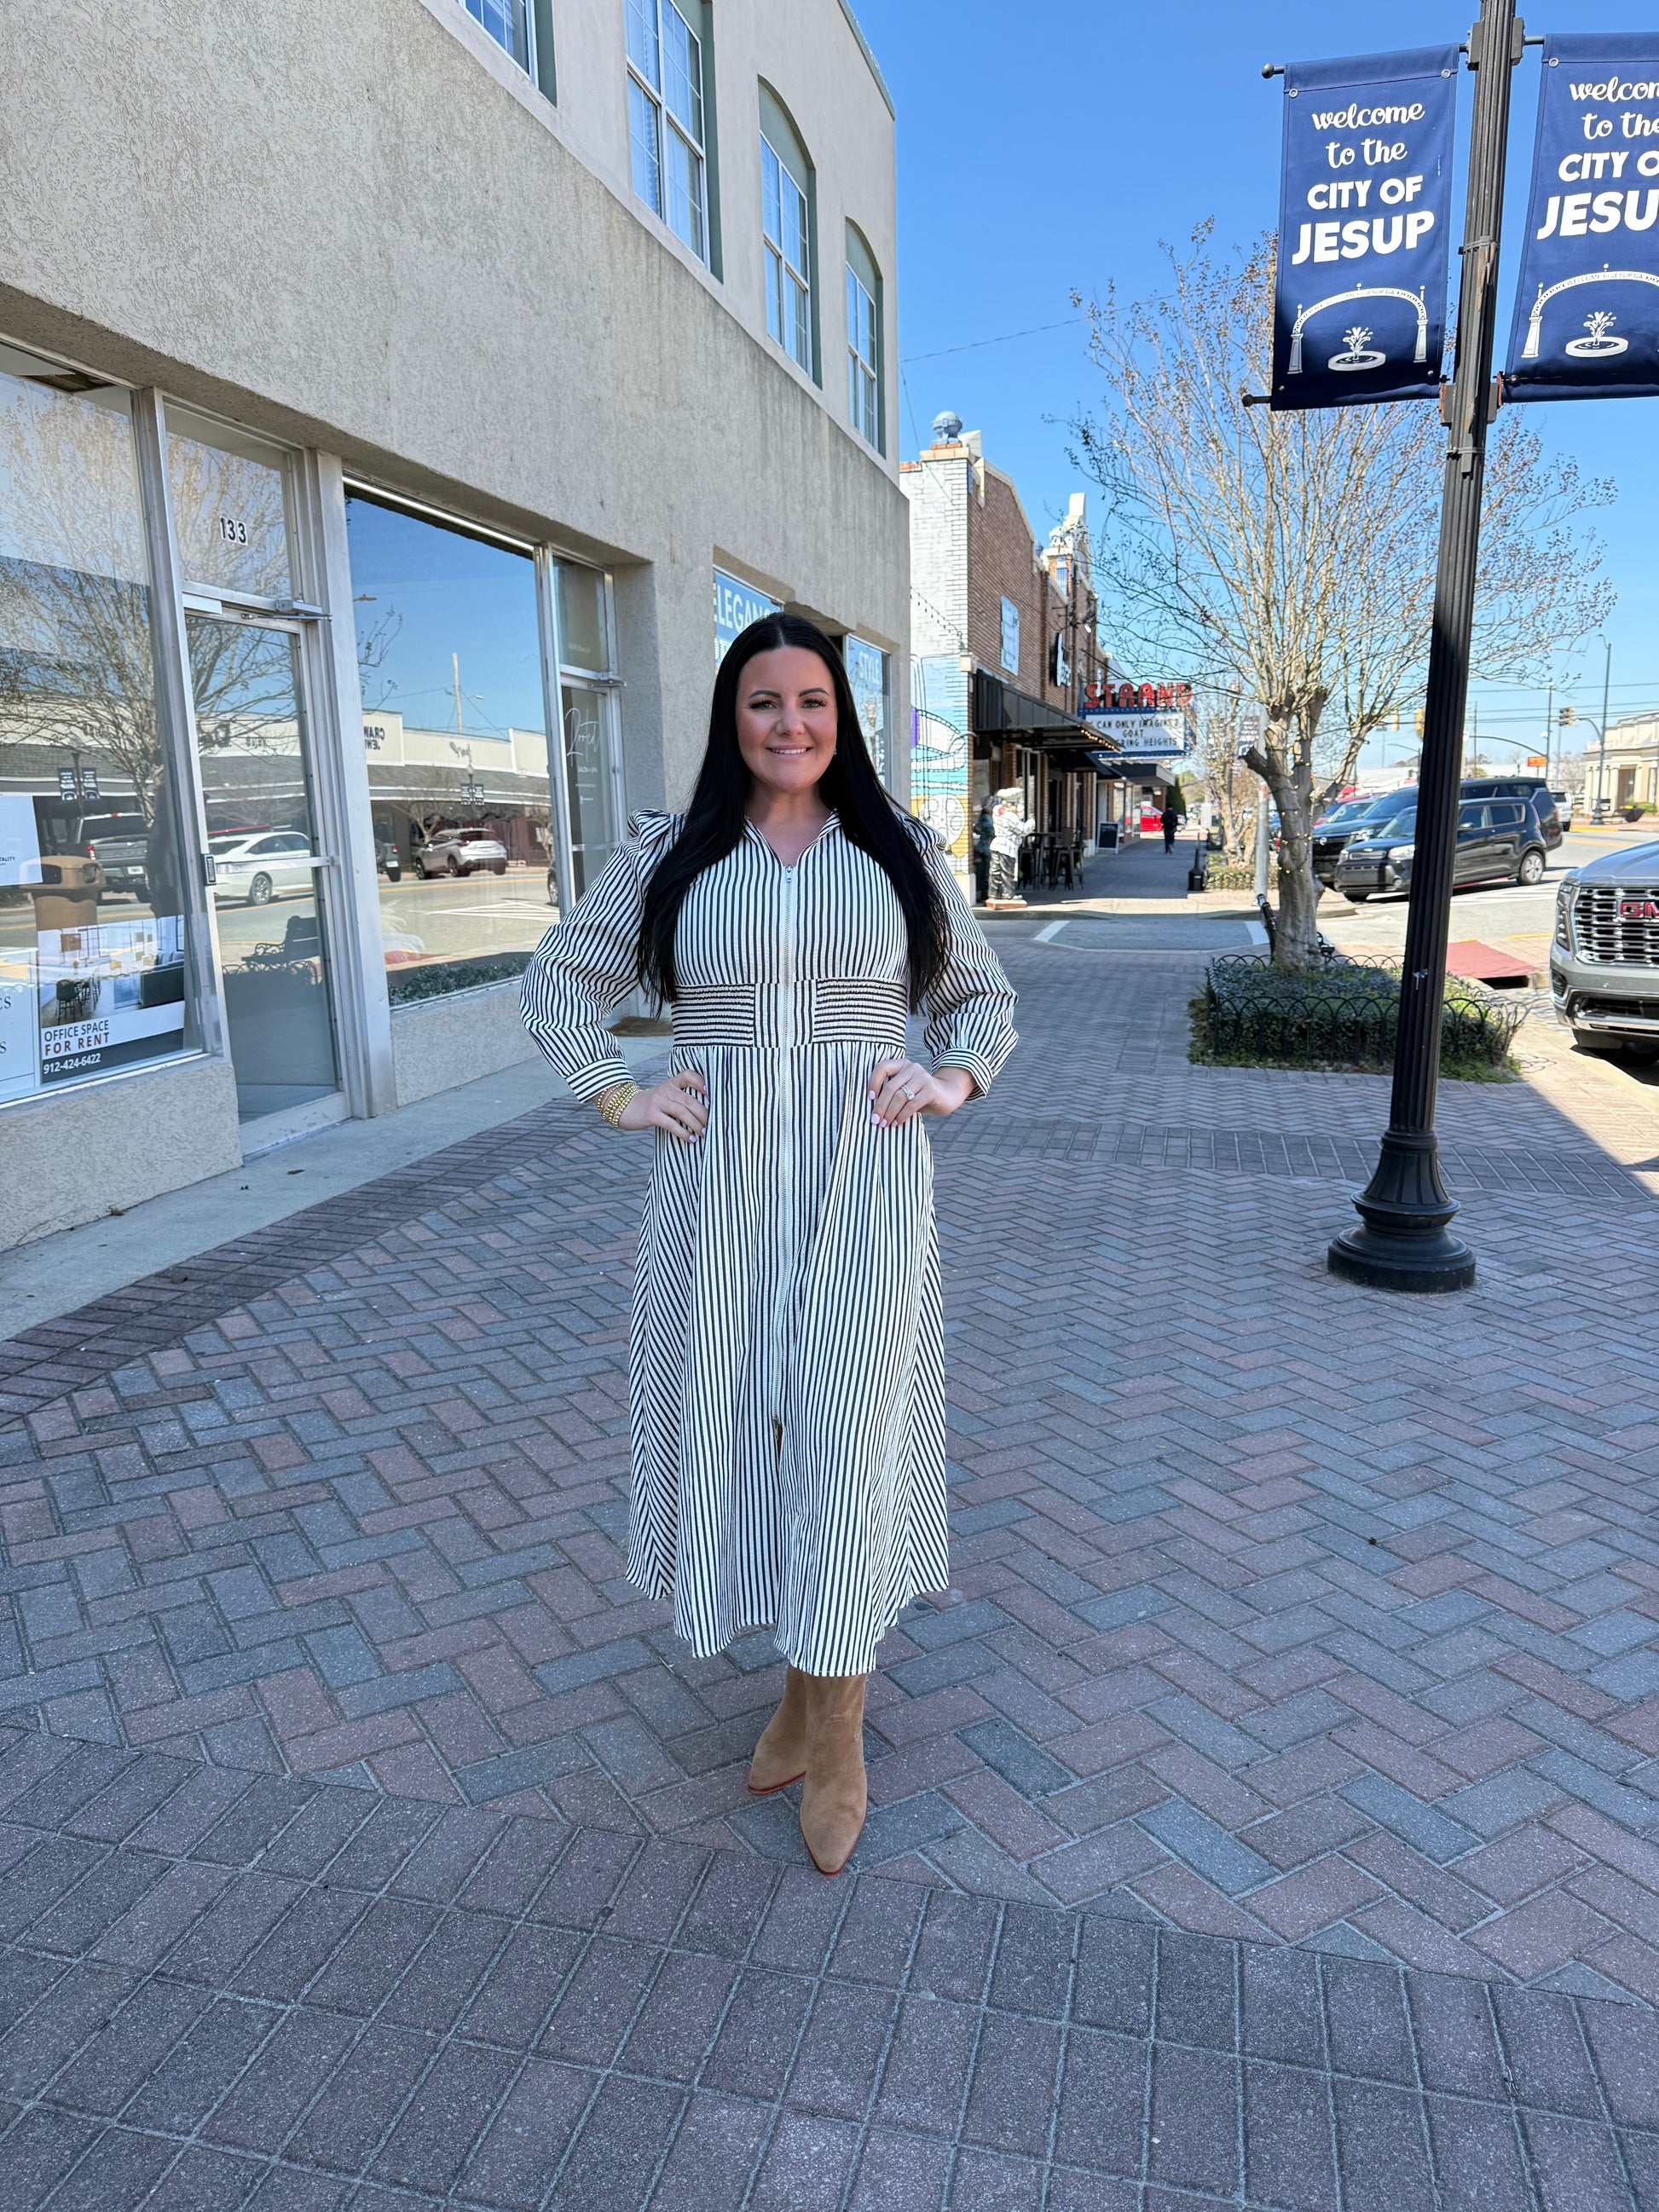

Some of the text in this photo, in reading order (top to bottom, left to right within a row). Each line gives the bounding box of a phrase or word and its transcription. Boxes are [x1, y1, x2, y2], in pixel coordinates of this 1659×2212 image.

[1311, 103, 1425, 130] welcome
[1581, 113, 1613, 140] to
[1326, 138, 1408, 168] to the
[1558, 150, 1659, 182] CITY O
[1307, 175, 1424, 210] CITY OF
[1536, 189, 1659, 240] JESU
[1292, 211, 1435, 265] JESUP
[221, 517, 246, 543] 133
[858, 650, 880, 684] STYLE
[1084, 682, 1193, 709] STRAND
[1115, 719, 1136, 729] ONLY
[1122, 729, 1144, 738] GOAT
[1143, 737, 1177, 747] HEIGHTS
[1621, 902, 1659, 918] GM
[44, 1020, 109, 1042] OFFICE SPACE
[45, 1032, 109, 1056] FOR RENT
[43, 1053, 101, 1075] 912-424-6422
